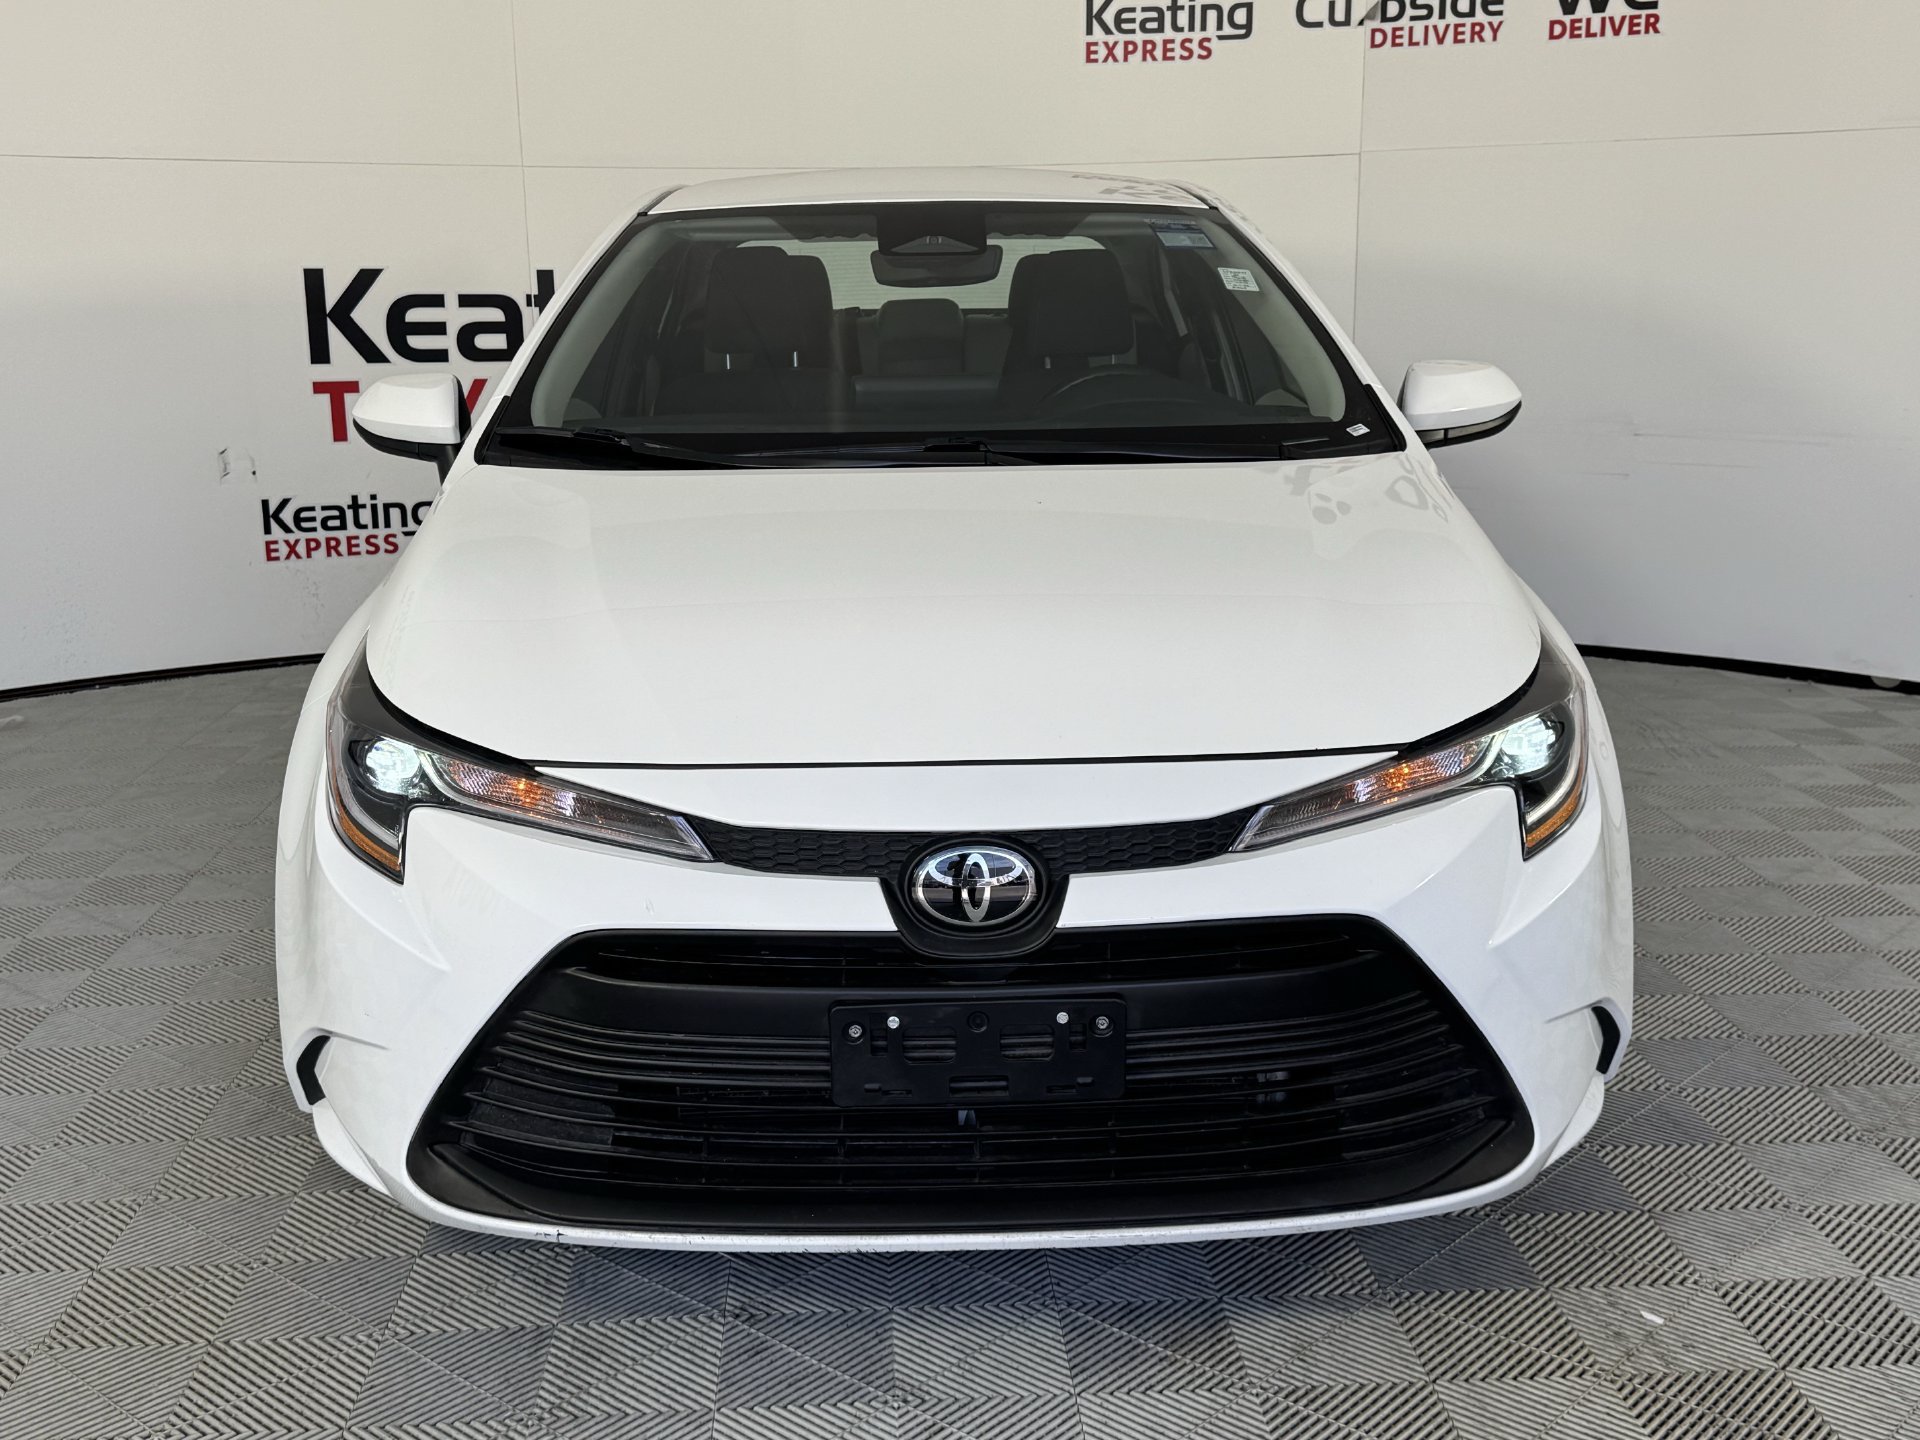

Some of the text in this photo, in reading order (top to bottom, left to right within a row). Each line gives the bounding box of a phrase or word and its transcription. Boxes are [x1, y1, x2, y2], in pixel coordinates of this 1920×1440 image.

[1085, 0, 1253, 40] Keating
[1295, 0, 1504, 28] Cubside
[1548, 13, 1661, 40] DELIVER
[1370, 20, 1504, 49] DELIVERY
[1085, 37, 1213, 63] EXPRESS
[264, 533, 400, 562] EXPRESS
